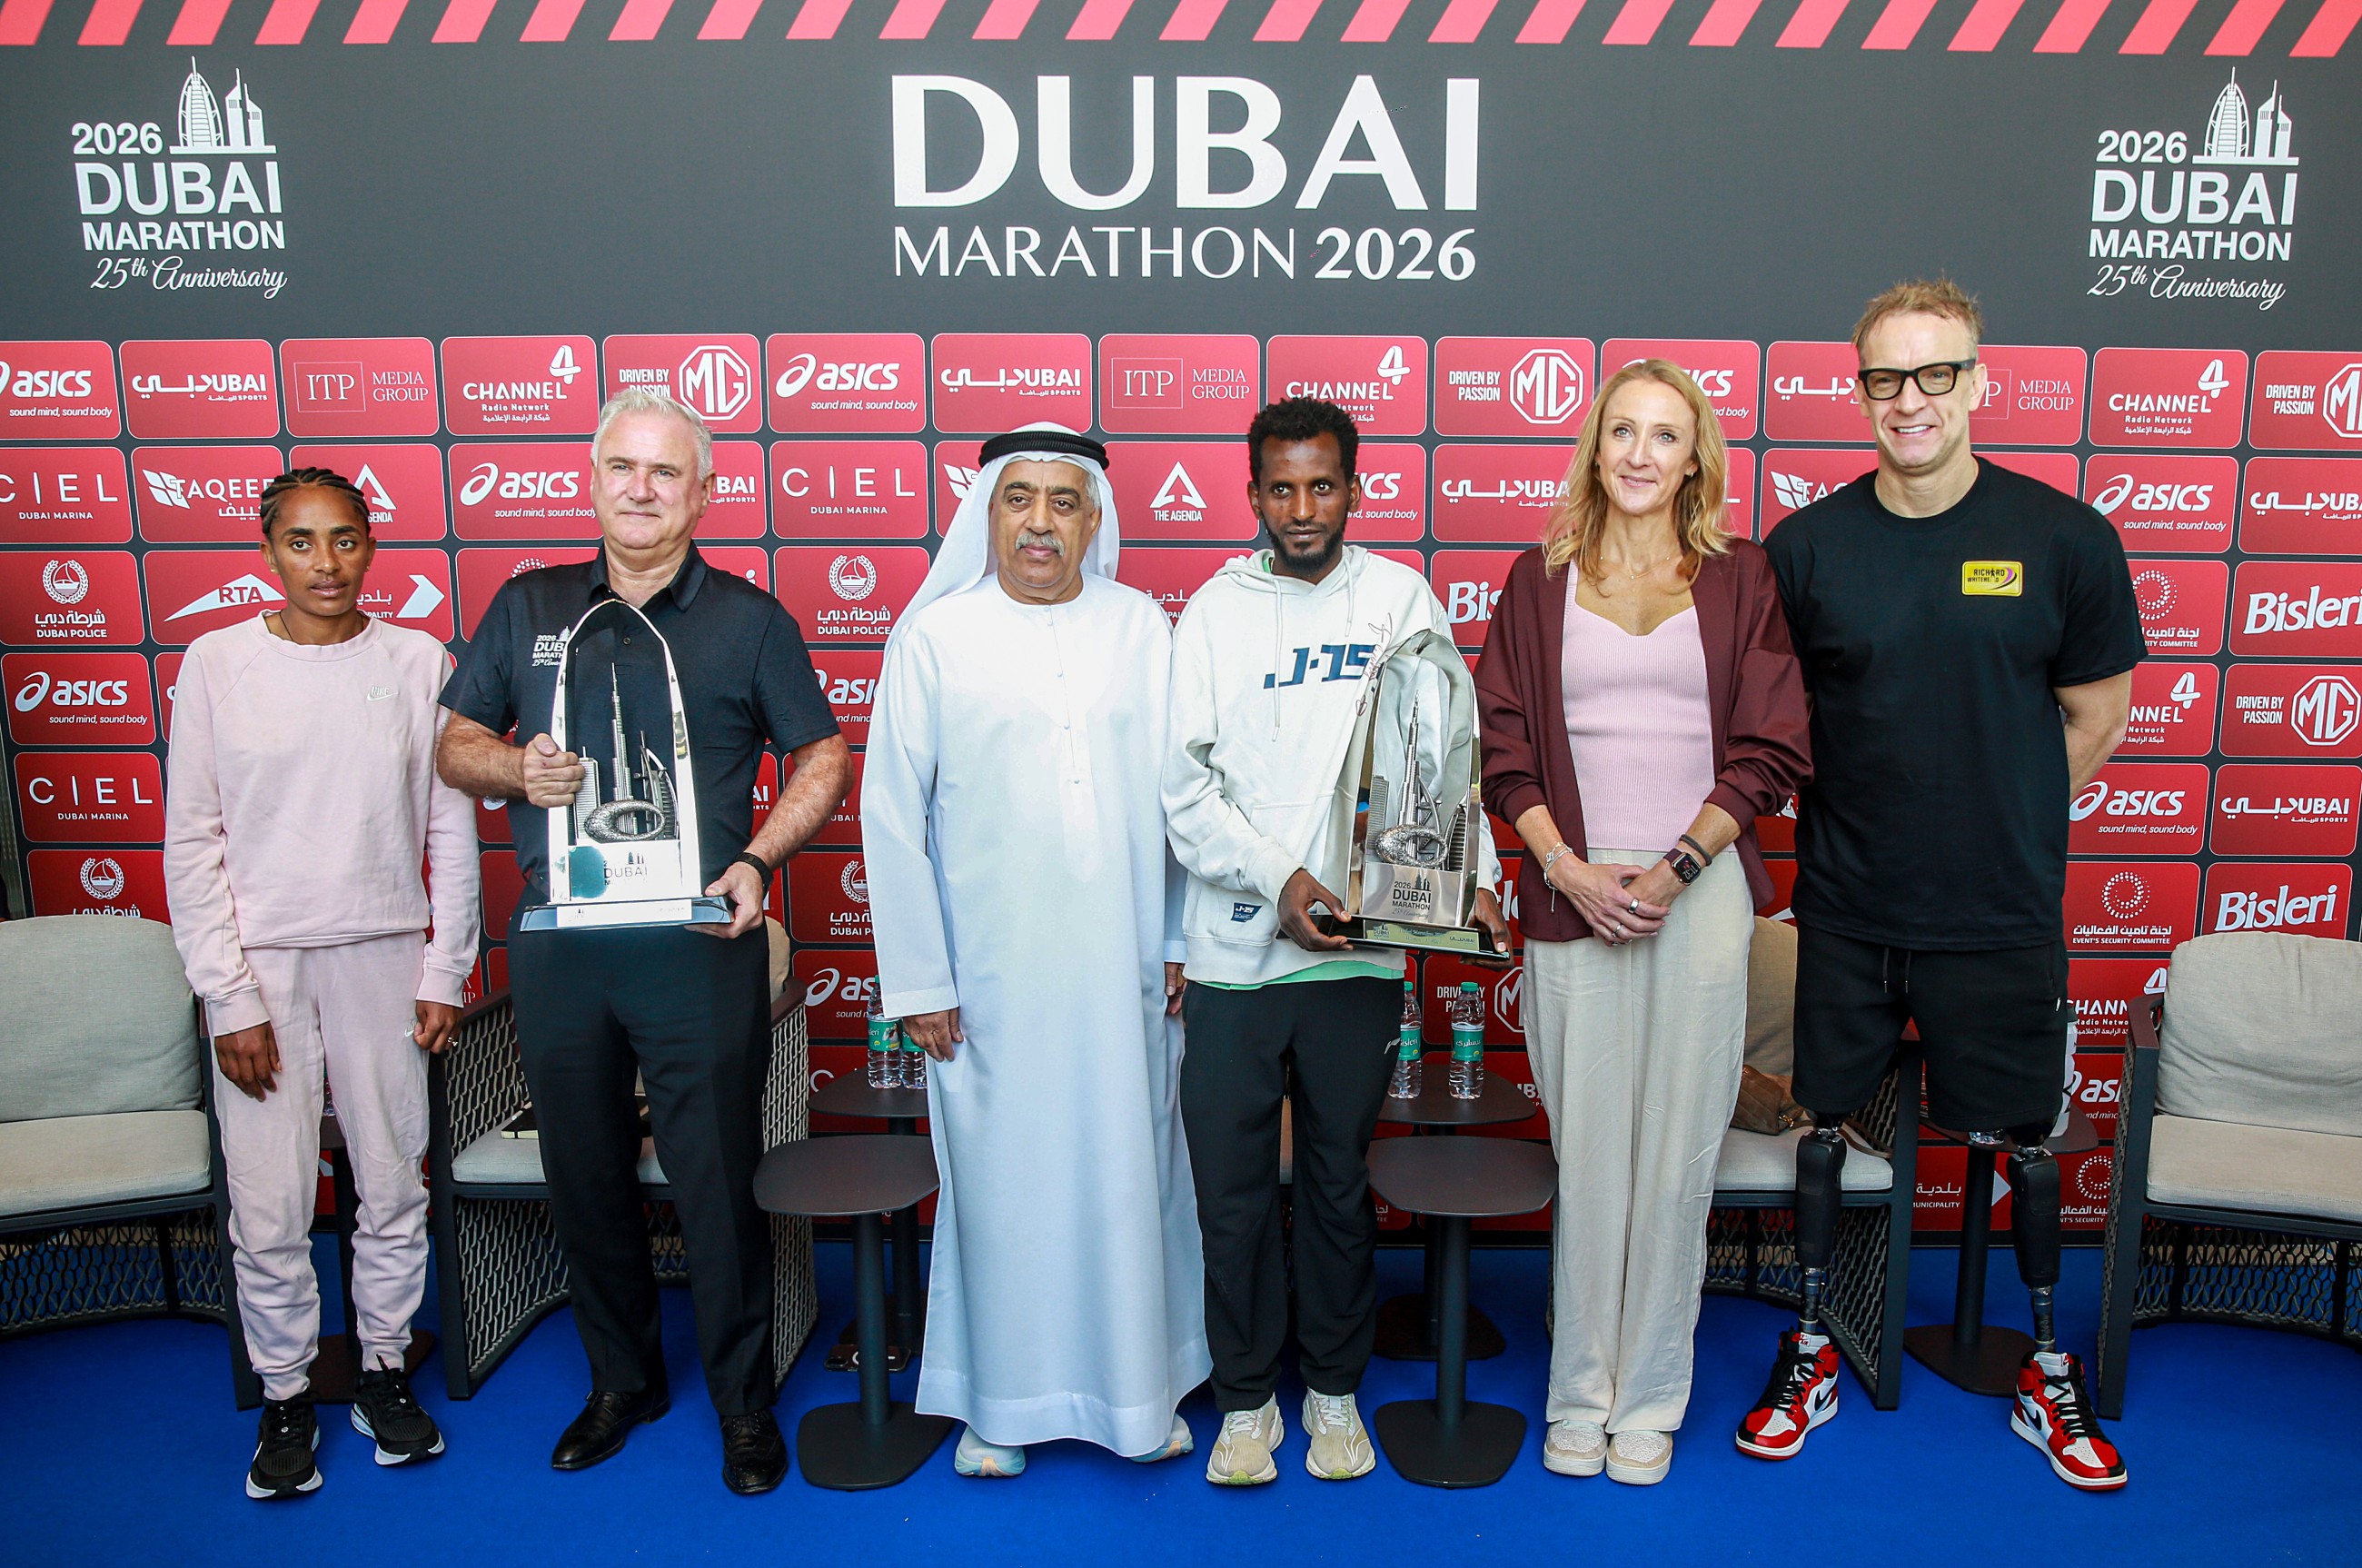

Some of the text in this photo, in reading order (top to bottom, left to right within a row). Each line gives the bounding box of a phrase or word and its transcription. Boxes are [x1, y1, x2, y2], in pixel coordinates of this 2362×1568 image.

[72, 123, 163, 154] 2026
[892, 74, 1479, 211] DUBAI
[2096, 130, 2187, 164] 2026
[74, 161, 282, 215] DUBAI
[2091, 170, 2297, 225] DUBAI
[83, 220, 285, 251] MARATHON
[2089, 229, 2291, 261] MARATHON
[895, 225, 1475, 281] MARATHON 2026
[90, 255, 288, 300] 25th Anniversary
[2087, 264, 2287, 311] 25th Anniversary
[372, 372, 424, 385] MEDIA
[619, 369, 670, 382] DRIVEN BY
[1193, 369, 1246, 382] MEDIA
[1449, 371, 1501, 385] DRIVEN BY
[306, 374, 354, 400] ITP
[686, 352, 744, 414] MG
[1124, 370, 1174, 396] ITP
[1517, 355, 1578, 417] MG
[2020, 380, 2071, 394] MEDIA
[373, 388, 429, 402] GROUP
[462, 381, 568, 401] CHANNEL
[1192, 385, 1250, 399] GROUP
[1285, 381, 1394, 401] CHANNEL
[1458, 387, 1500, 401] PASSION
[2266, 384, 2316, 399] DRIVEN BY
[481, 403, 508, 412] Radio
[810, 400, 839, 410] sound
[865, 400, 894, 410] sound
[894, 400, 918, 412] body
[2018, 396, 2074, 411] GROUP
[2108, 392, 2212, 414] CHANNEL
[2273, 401, 2315, 414] PASSION
[9, 407, 36, 416] sound
[62, 407, 89, 416] sound
[90, 407, 113, 418] body
[1727, 406, 1750, 419] body
[2125, 415, 2192, 424] Radio Network
[367, 511, 393, 523] GENDA
[494, 508, 522, 517] sound
[547, 507, 575, 517] sound
[575, 507, 596, 519] body
[810, 506, 888, 514] DUBAI MARINA
[1154, 510, 1203, 522] THE AGENDA
[1365, 509, 1418, 521] sound body
[2123, 520, 2151, 529] sound
[2176, 521, 2204, 530] sound
[2203, 521, 2227, 532] body
[218, 586, 263, 604] RTA
[2242, 584, 2362, 635] Bisleri
[36, 629, 107, 638] DUBAI POLICE
[818, 626, 892, 635] DUBAI POLICE
[533, 641, 564, 652] DUB
[532, 651, 563, 660] MARATH
[2236, 696, 2284, 709] DRIVEN BY
[2243, 710, 2283, 724] PASSION
[2297, 682, 2355, 739] MG
[49, 714, 75, 723] sound
[99, 714, 125, 723] sound
[126, 714, 147, 725] body
[2098, 824, 2125, 833] sound
[2149, 825, 2176, 833] sound
[2176, 825, 2198, 836] body
[1394, 880, 1412, 889] 2026
[1393, 888, 1432, 904] DUBAI
[1392, 900, 1431, 911] MARATHON
[2214, 885, 2337, 932] Bisleri
[830, 928, 862, 936] DUBAI
